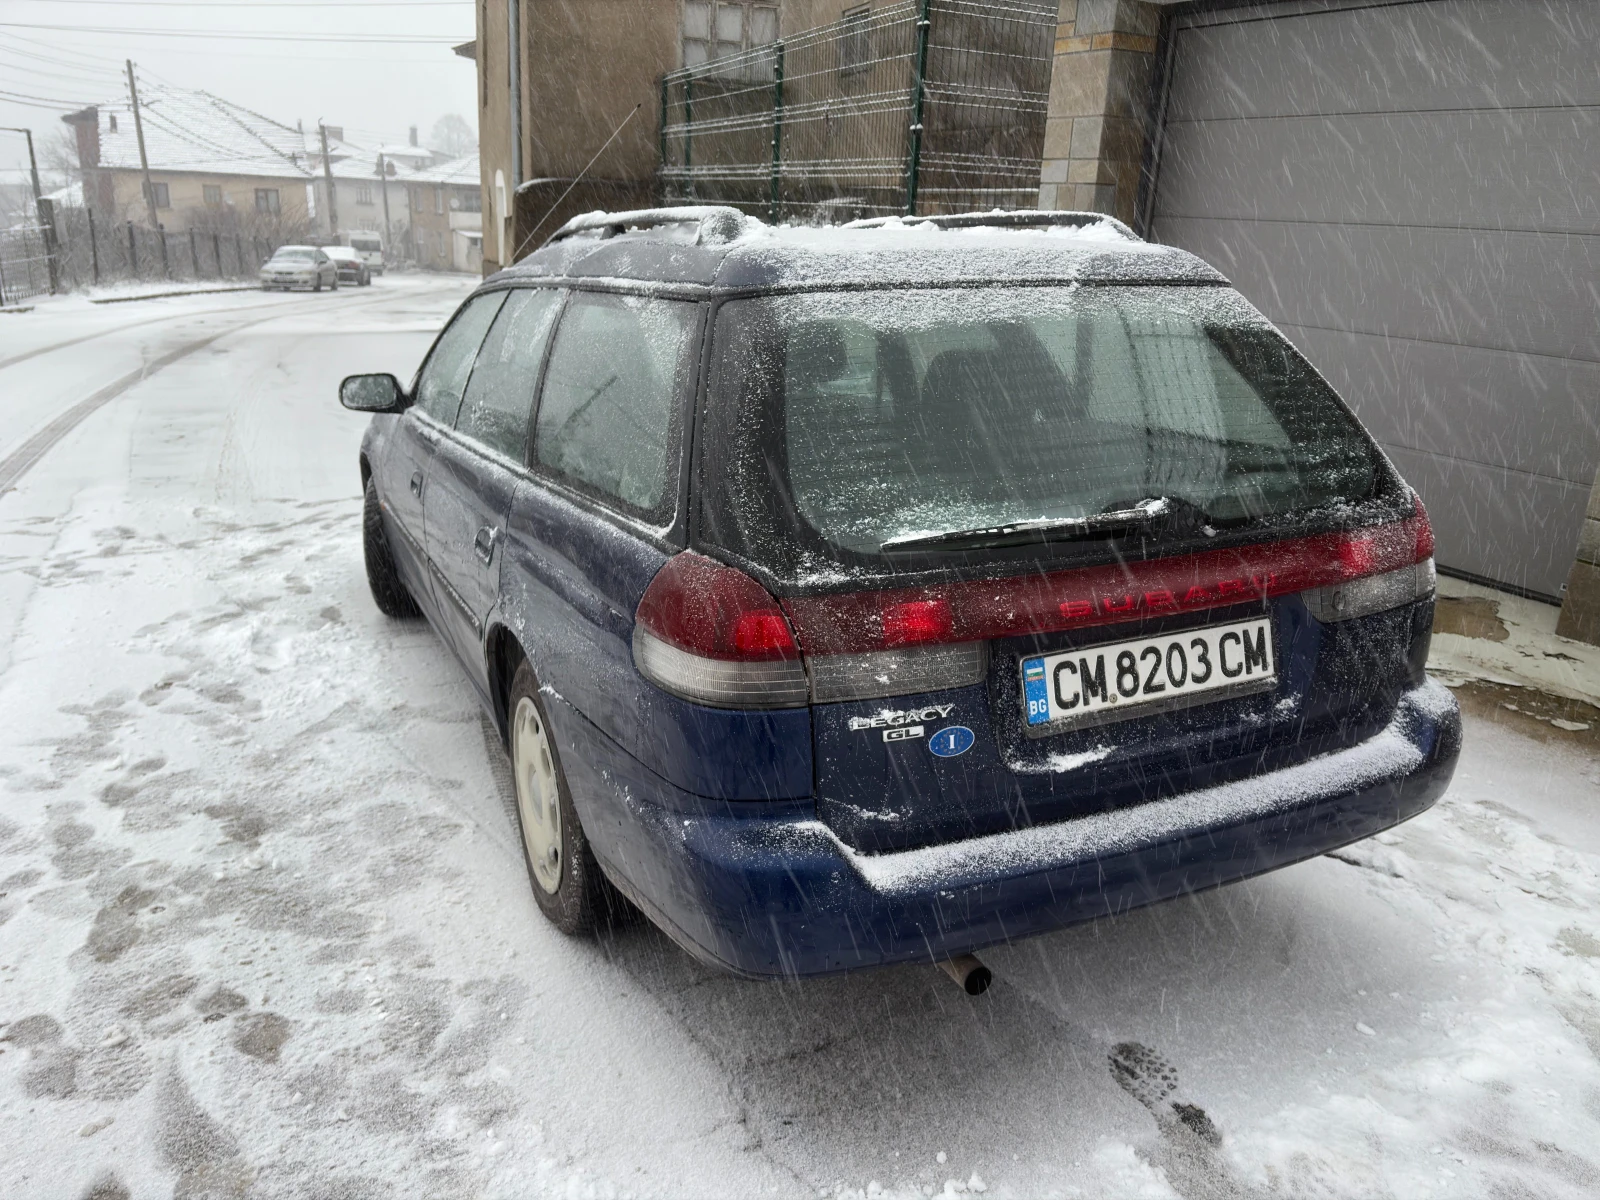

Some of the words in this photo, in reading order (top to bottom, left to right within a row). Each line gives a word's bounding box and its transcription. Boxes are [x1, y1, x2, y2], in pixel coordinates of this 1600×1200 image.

[1059, 573, 1277, 617] SUBARU
[1116, 637, 1212, 698] 8203
[1218, 626, 1269, 678] CM
[849, 703, 955, 730] LEGACY
[1029, 699, 1047, 716] BG
[886, 728, 921, 741] GL
